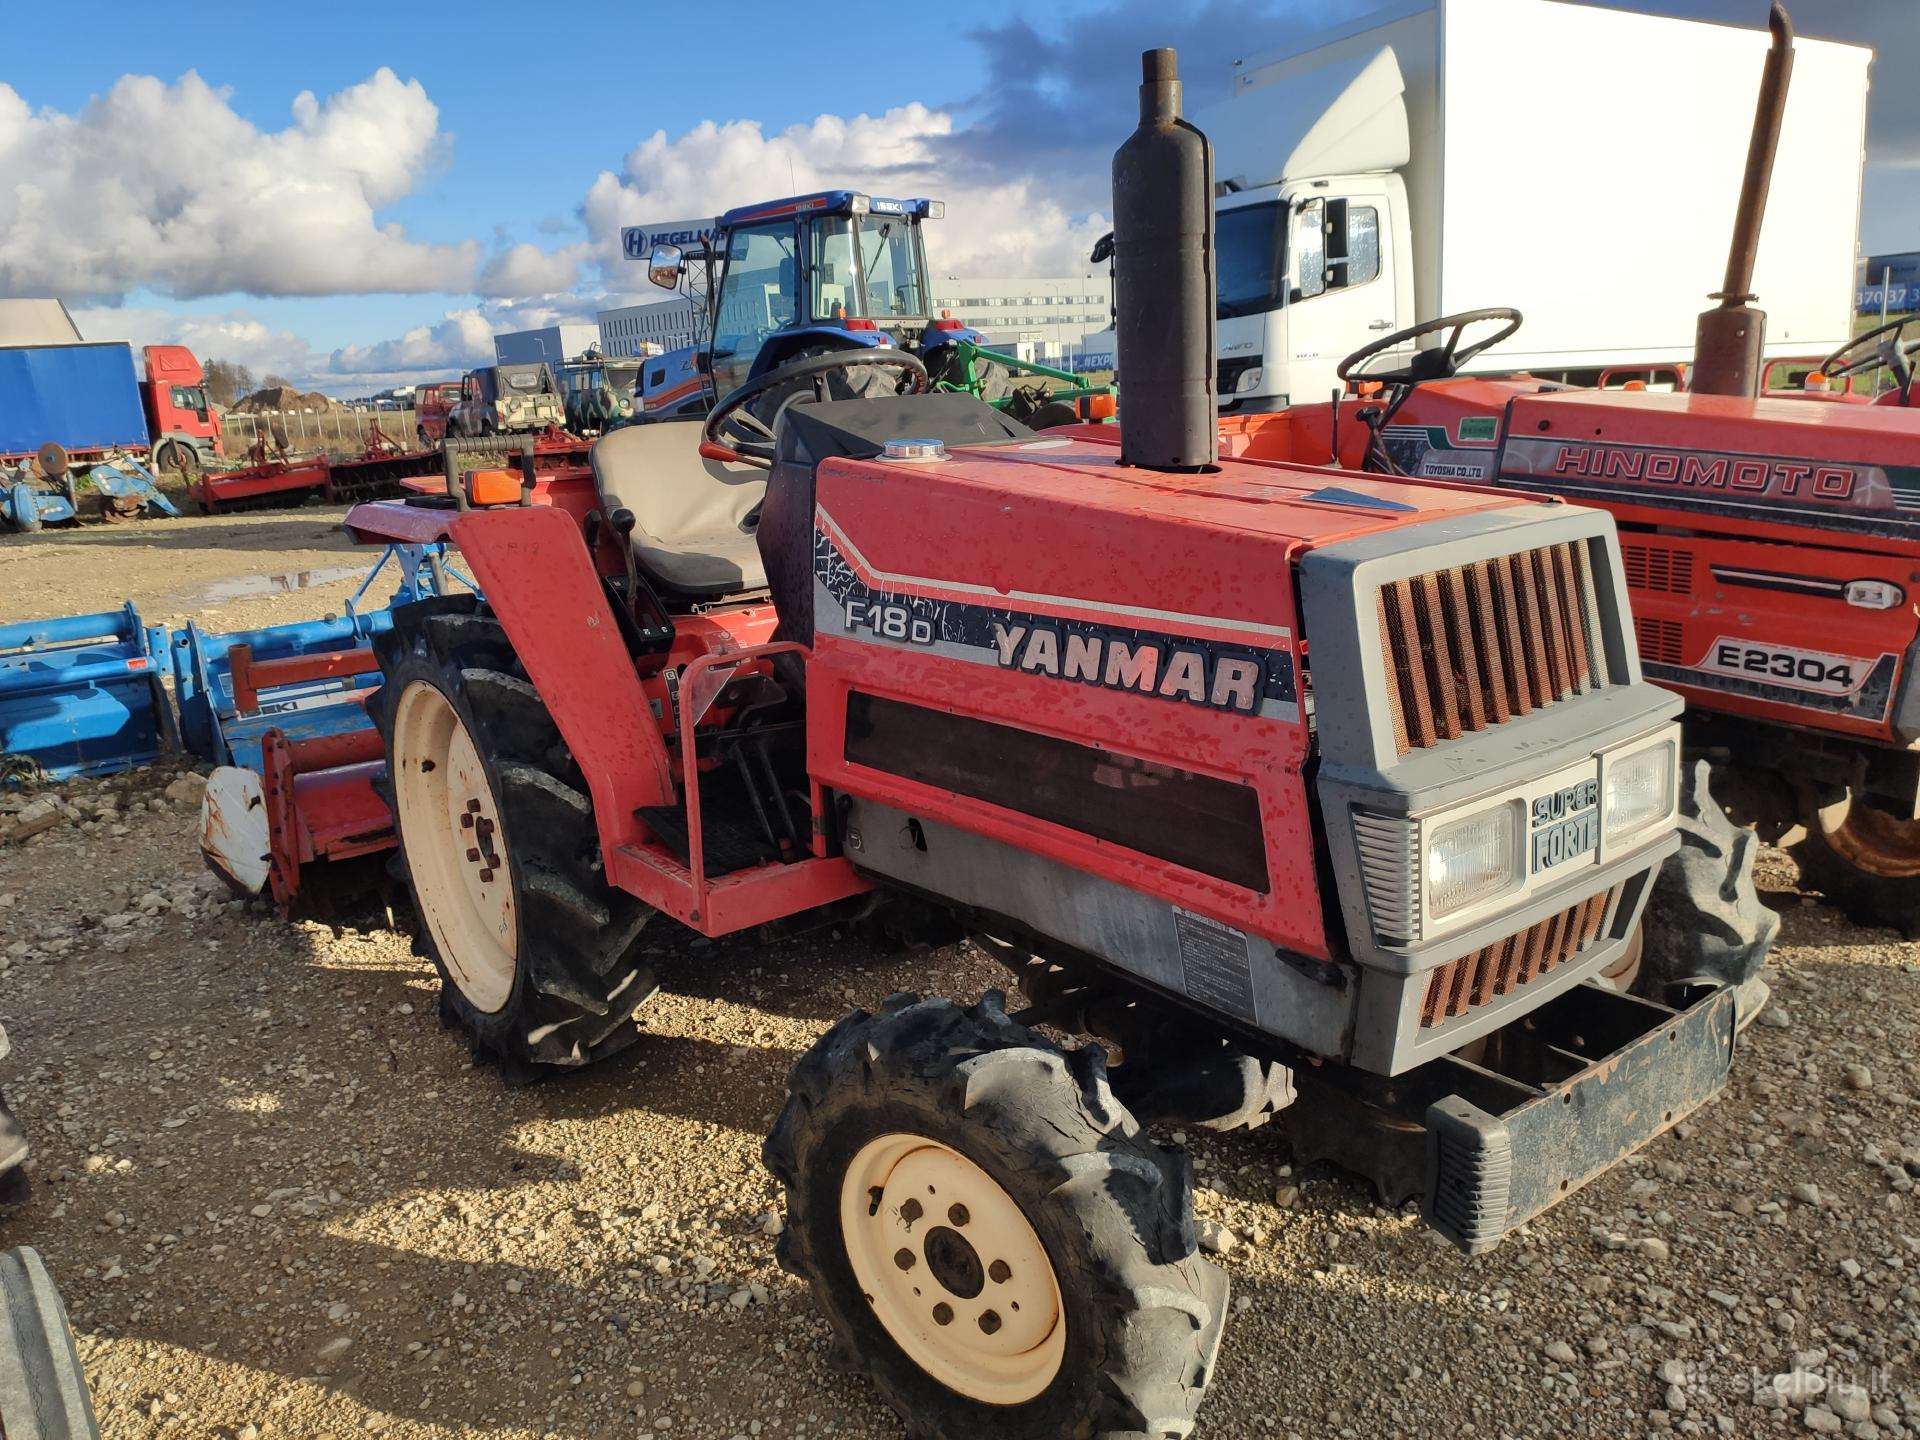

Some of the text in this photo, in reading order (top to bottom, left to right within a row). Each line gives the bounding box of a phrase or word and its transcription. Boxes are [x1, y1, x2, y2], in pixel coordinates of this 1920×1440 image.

[1425, 465, 1455, 476] TOYOSHA
[1556, 446, 1857, 499] HINOMOTO
[995, 622, 1261, 710] YANMAR
[1717, 645, 1853, 688] E2304
[243, 701, 298, 718] EKI
[1532, 778, 1599, 828] SUPER
[1532, 808, 1599, 874] FORTE
